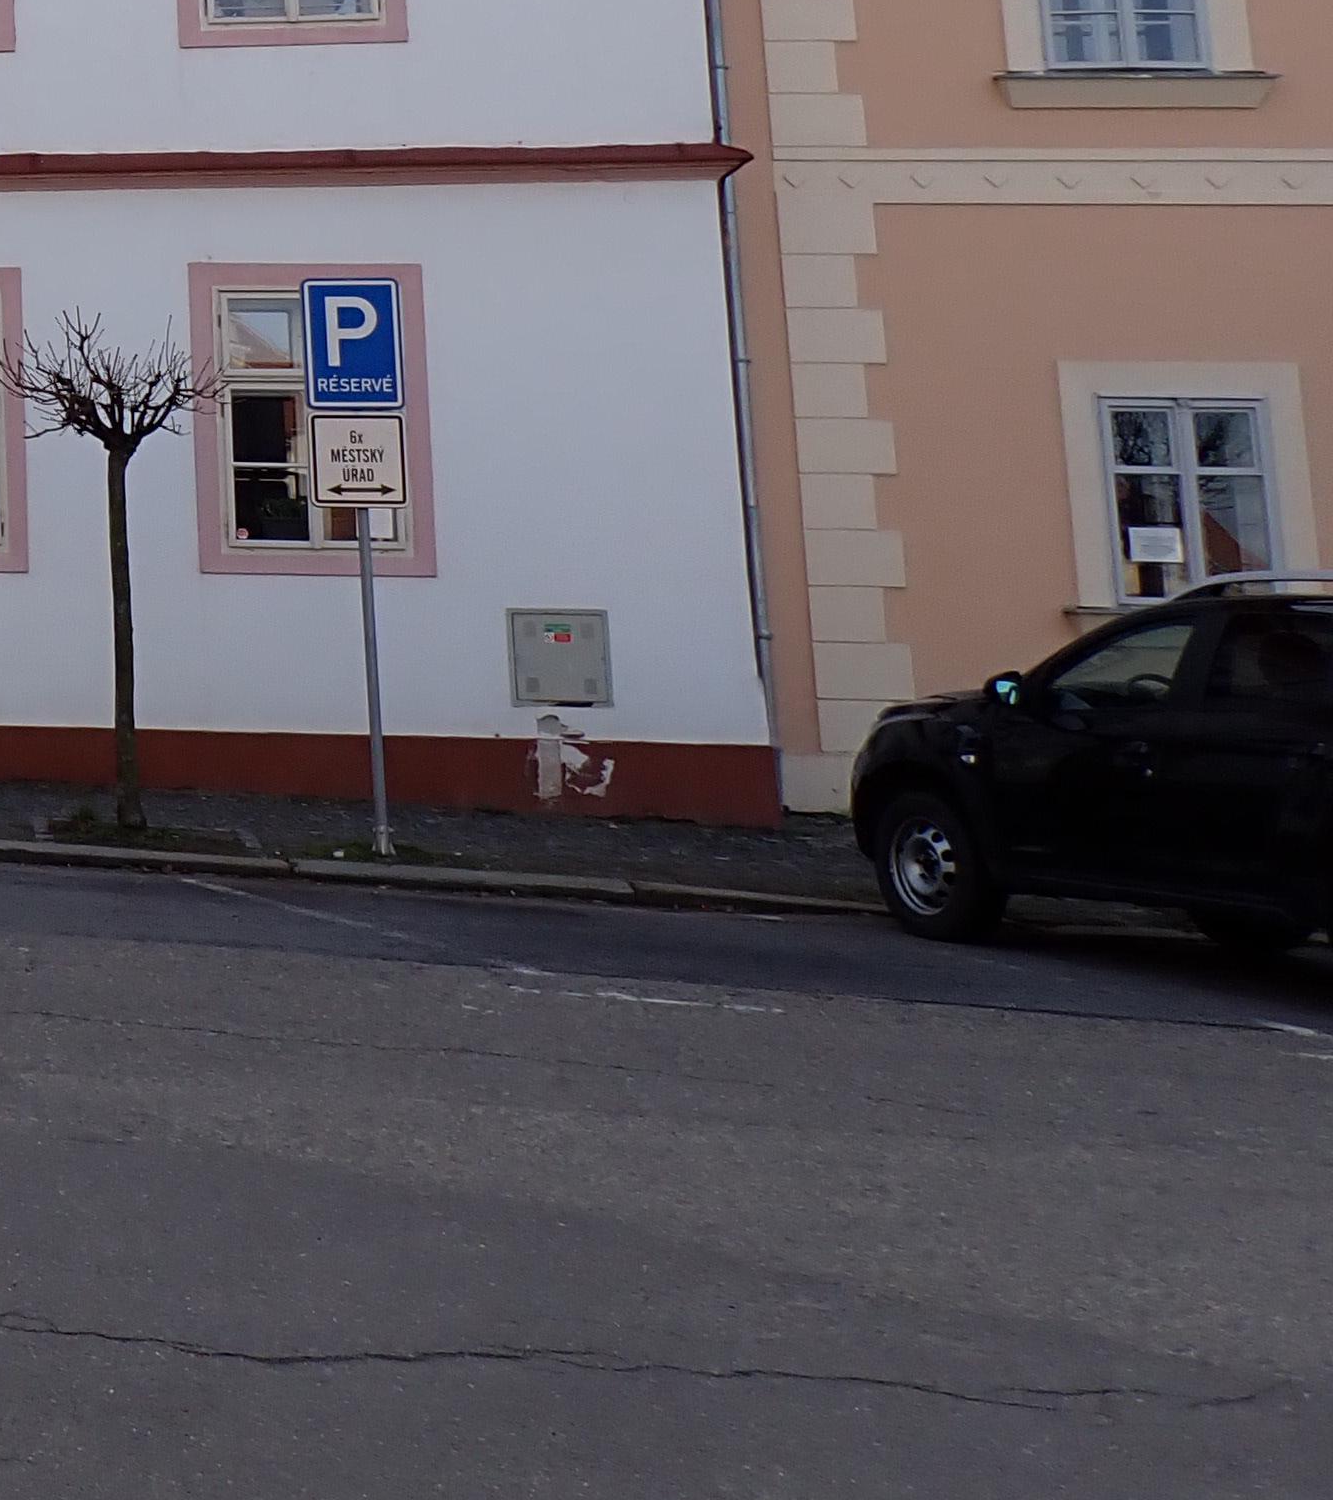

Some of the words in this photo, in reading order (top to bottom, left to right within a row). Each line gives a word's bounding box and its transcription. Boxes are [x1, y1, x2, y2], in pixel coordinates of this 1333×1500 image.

[324, 296, 378, 367] P
[318, 374, 393, 393] RÉSERVÉ
[349, 430, 363, 444] 6x
[330, 446, 384, 463] MĚSTSKÝ
[342, 465, 375, 483] ÚŘAD
